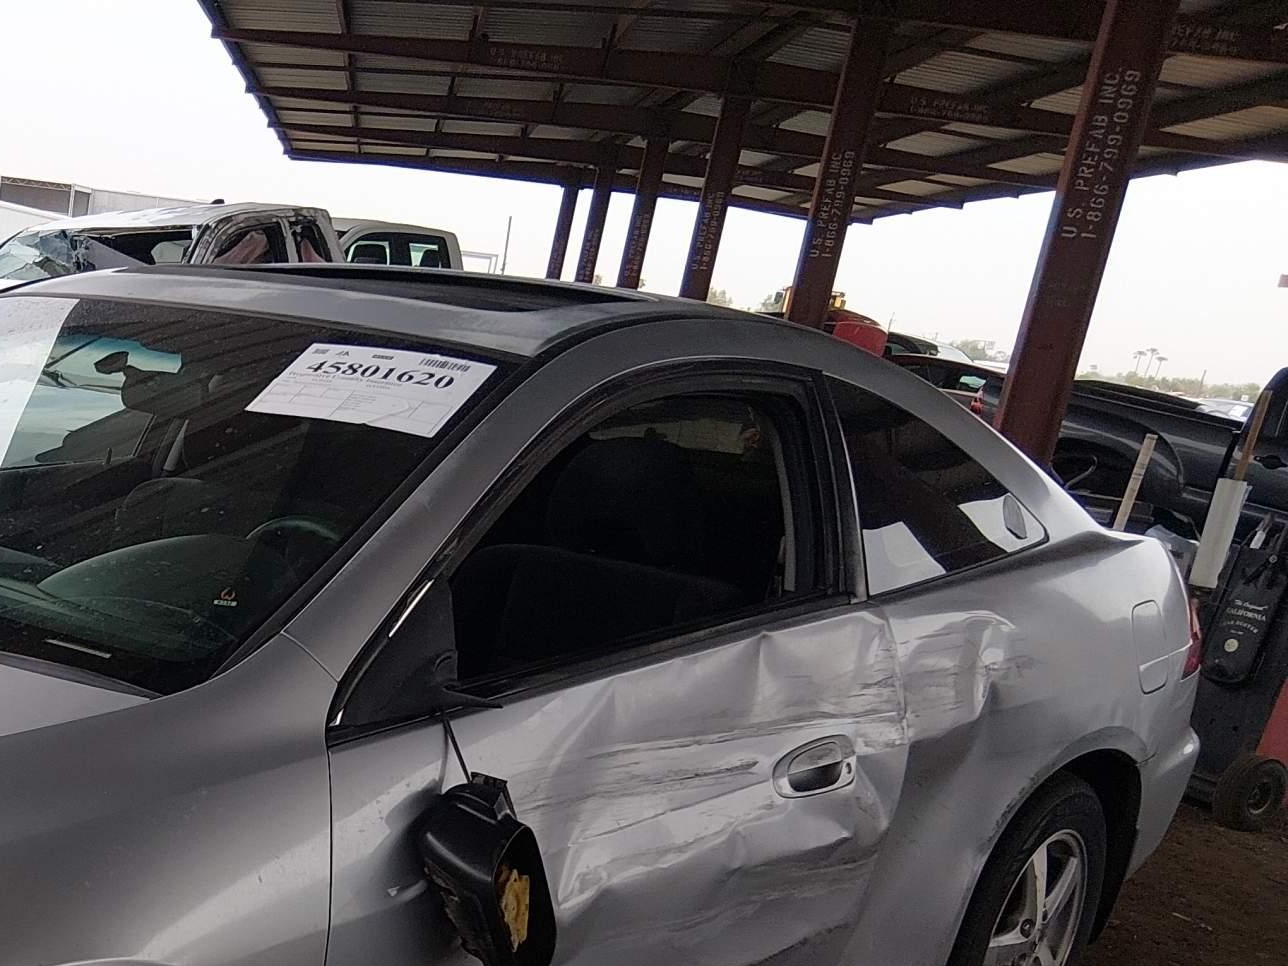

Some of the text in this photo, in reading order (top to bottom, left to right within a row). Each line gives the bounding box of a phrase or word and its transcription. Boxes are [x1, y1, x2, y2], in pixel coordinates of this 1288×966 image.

[1074, 115, 1108, 191] PREFAB
[1080, 70, 1142, 239] 1-866-799-0969
[306, 359, 455, 390] 45801620
